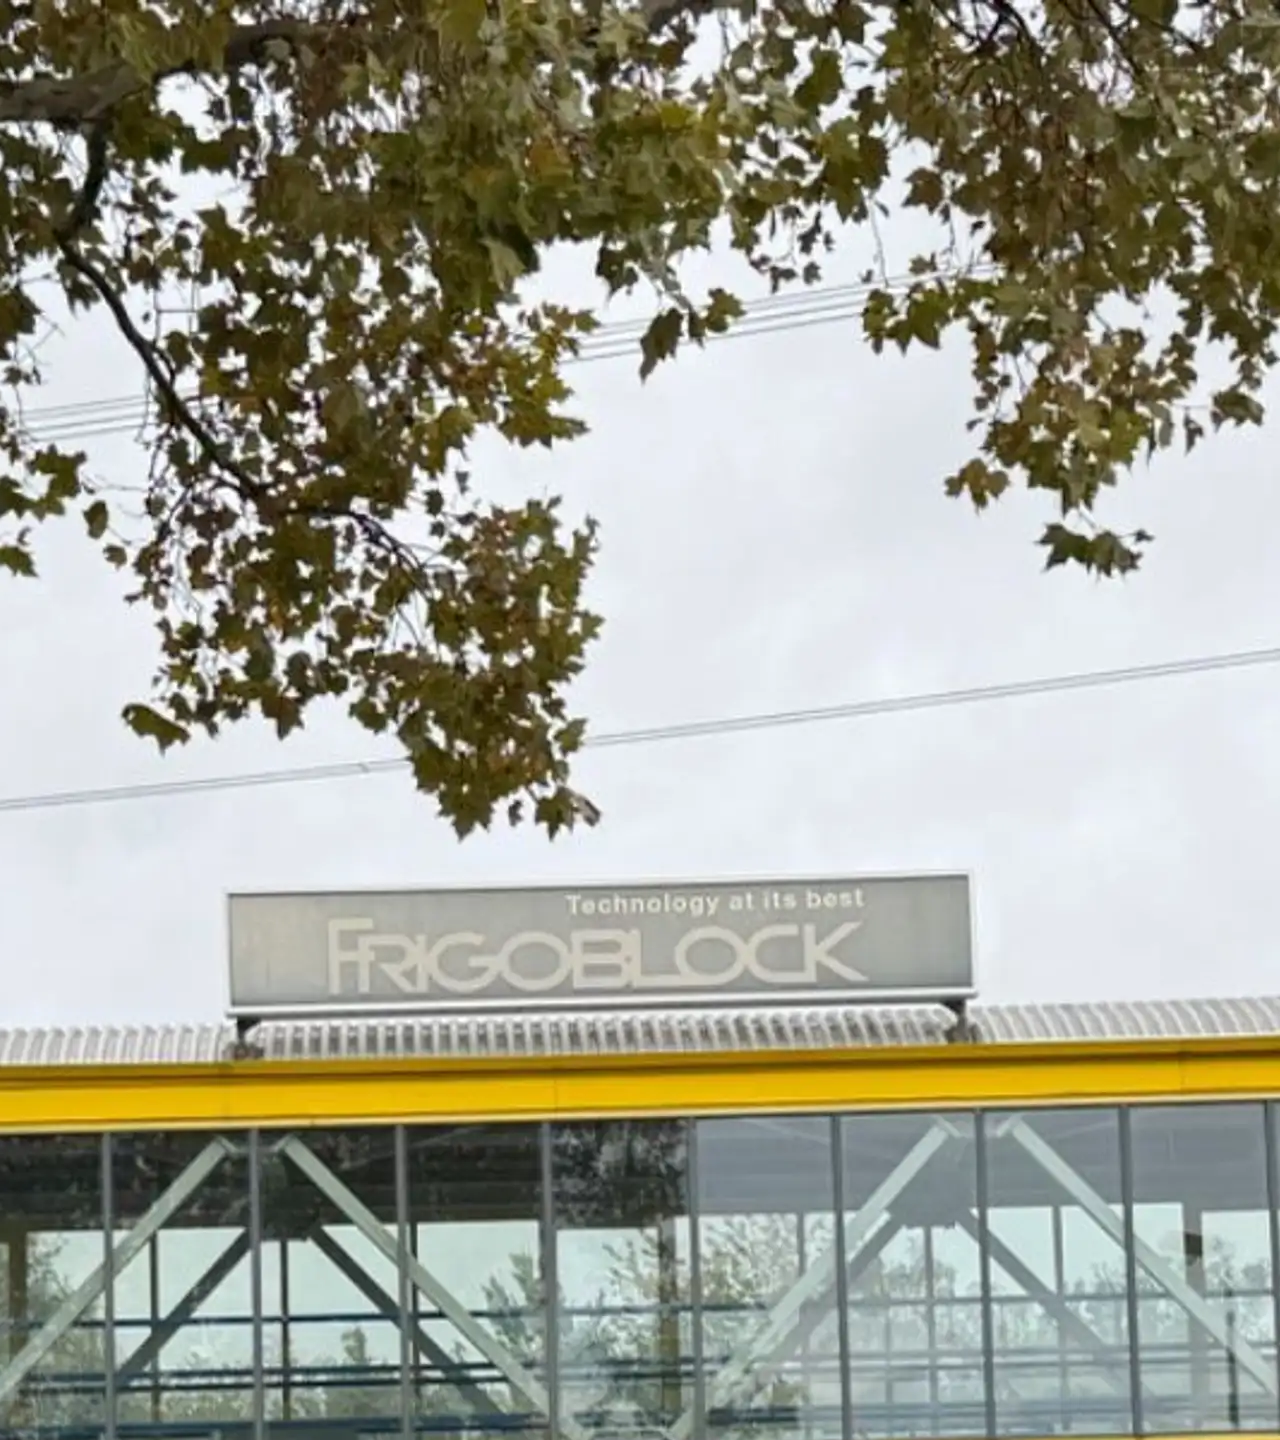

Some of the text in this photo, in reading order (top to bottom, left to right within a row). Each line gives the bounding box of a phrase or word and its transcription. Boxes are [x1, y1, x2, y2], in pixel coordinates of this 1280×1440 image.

[565, 888, 866, 917] Technology at its best
[328, 917, 869, 995] FRIGOBLOCK
